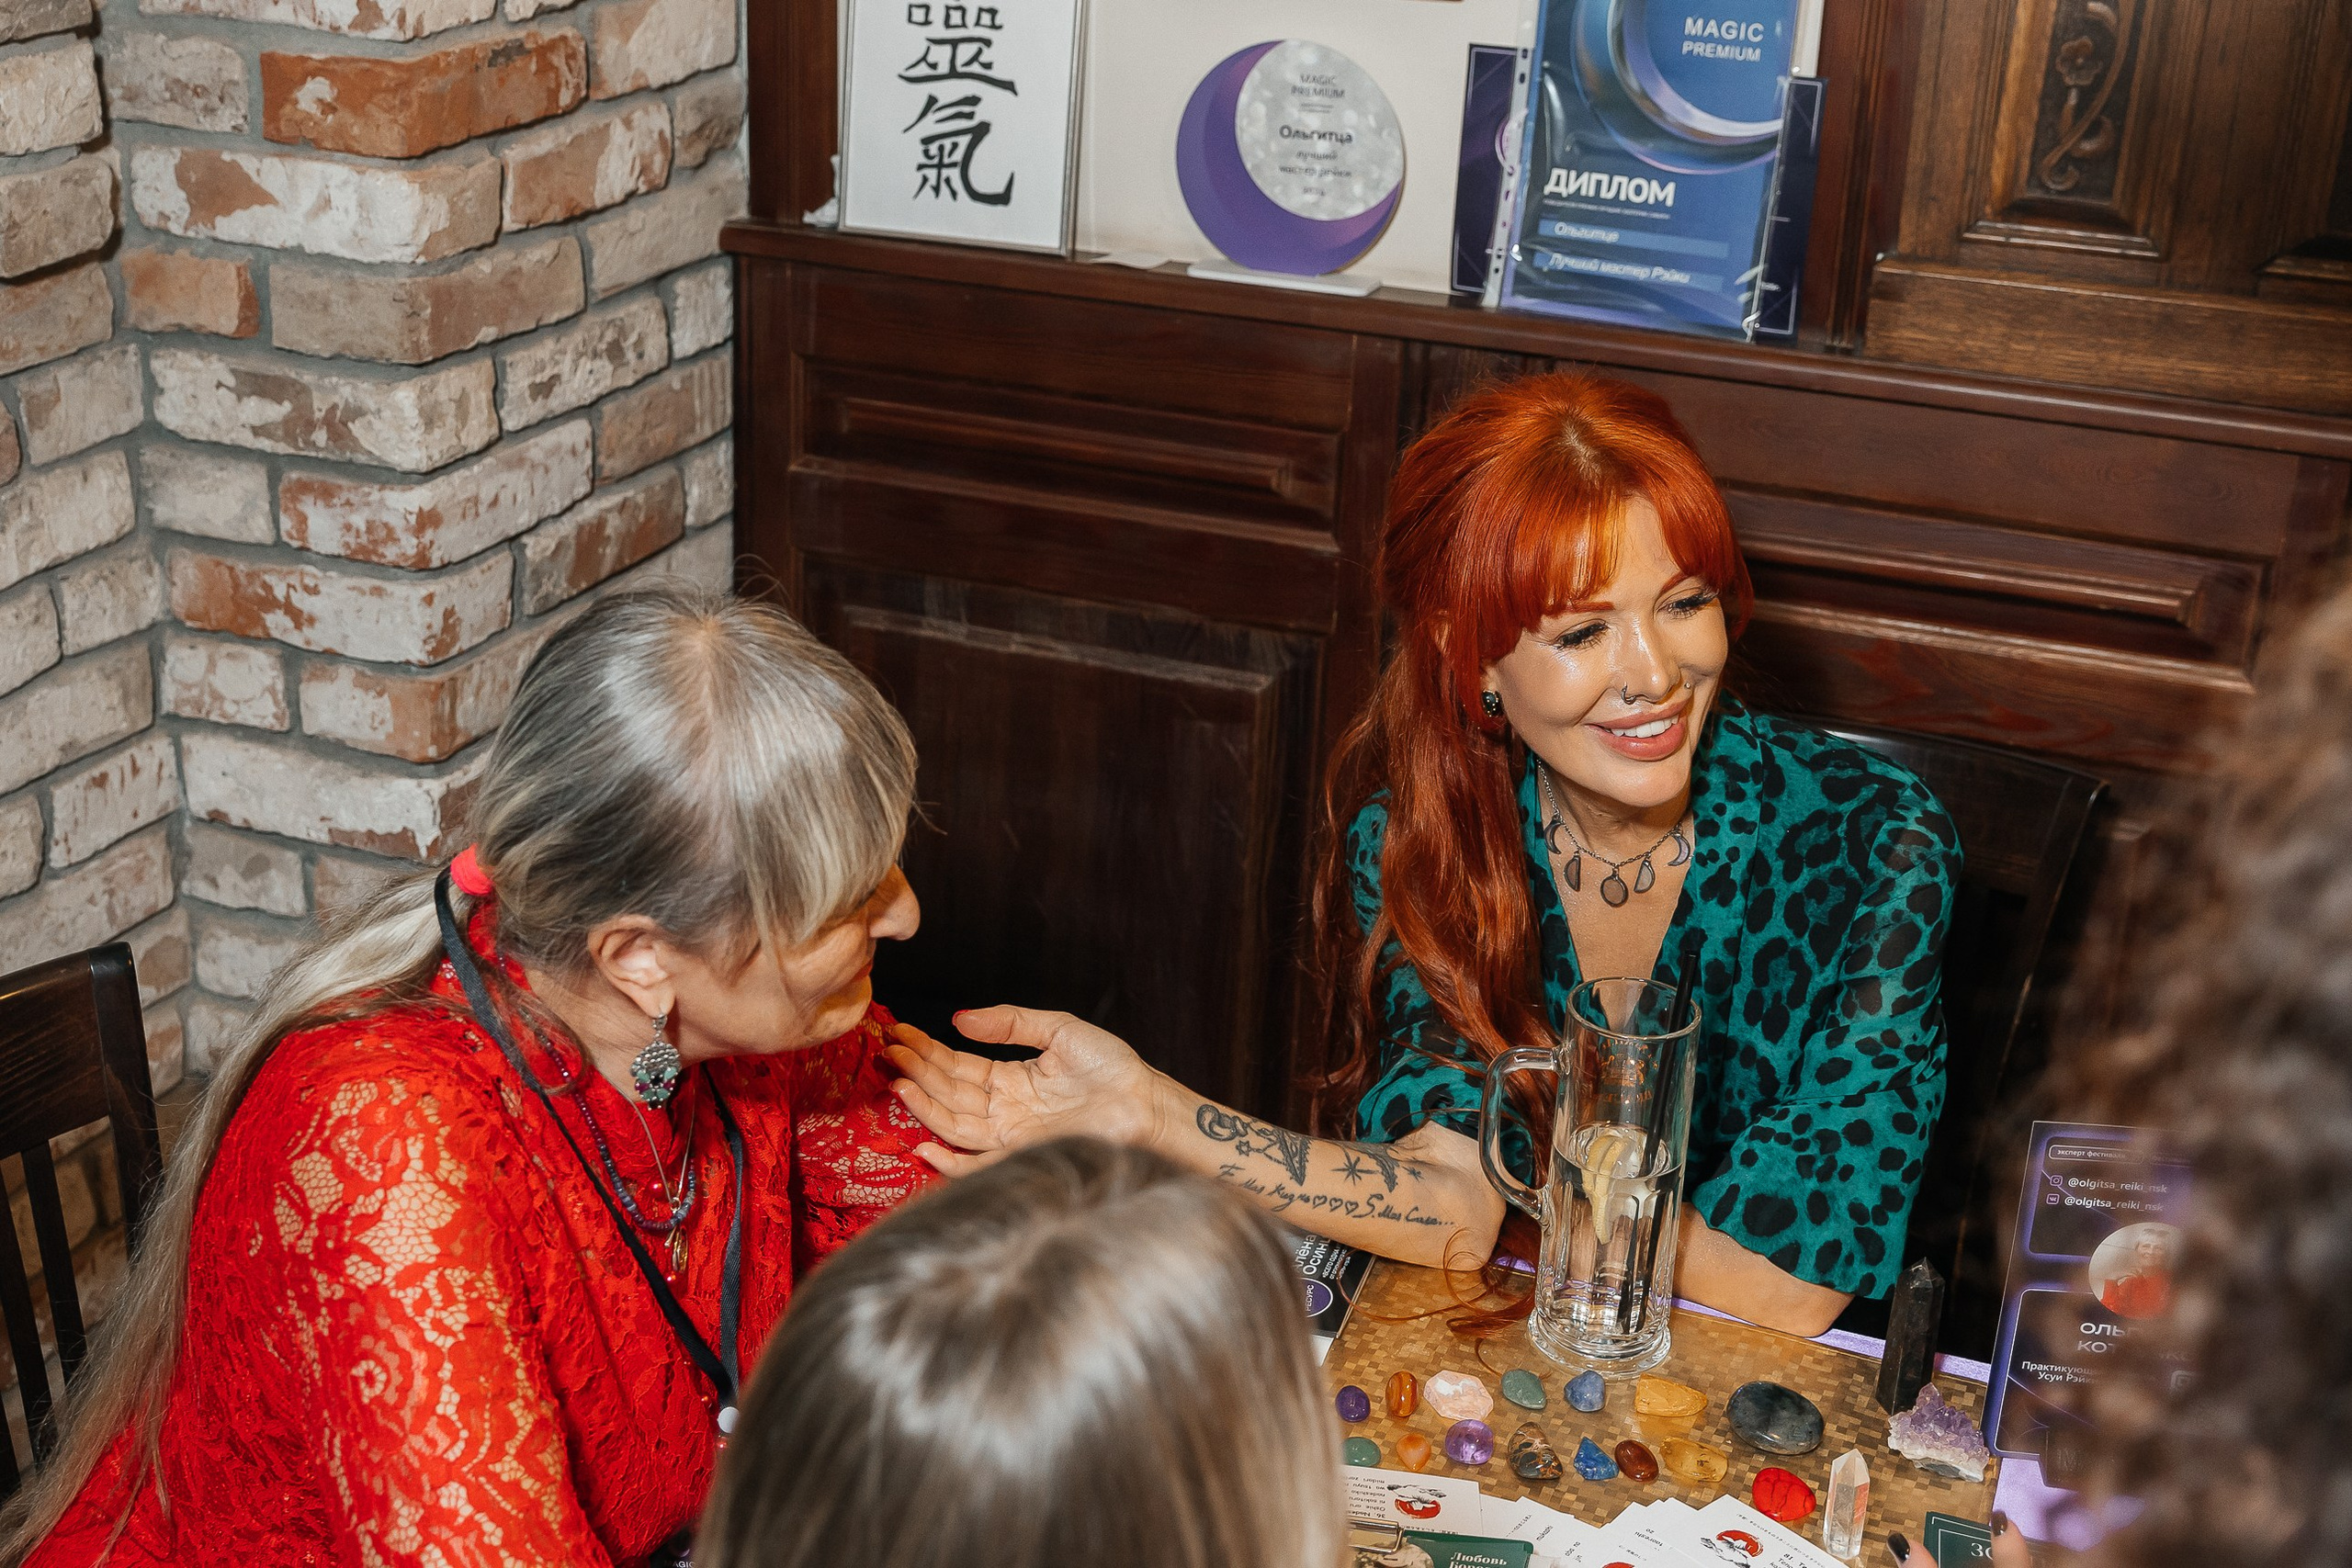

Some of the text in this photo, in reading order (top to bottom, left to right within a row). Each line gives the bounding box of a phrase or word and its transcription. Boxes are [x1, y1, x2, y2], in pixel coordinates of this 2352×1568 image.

[1684, 16, 1765, 43] MAGIC
[1681, 40, 1761, 62] PREMIUM
[1544, 168, 1677, 208] ДИПЛОМ
[1600, 260, 1651, 280] мастер
[2057, 1149, 2085, 1157] эксперт
[2067, 1177, 2168, 1194] @olgitsa_reiki_nsk
[2064, 1195, 2165, 1213] @olgitsa_reiki_nsk
[2080, 1322, 2139, 1337] ОЛЬ
[2021, 1360, 2098, 1376] Практикующ
[2038, 1371, 2063, 1382] Усуи
[1347, 1509, 1371, 1517] Nades
[1450, 1552, 1508, 1565] Любовь
